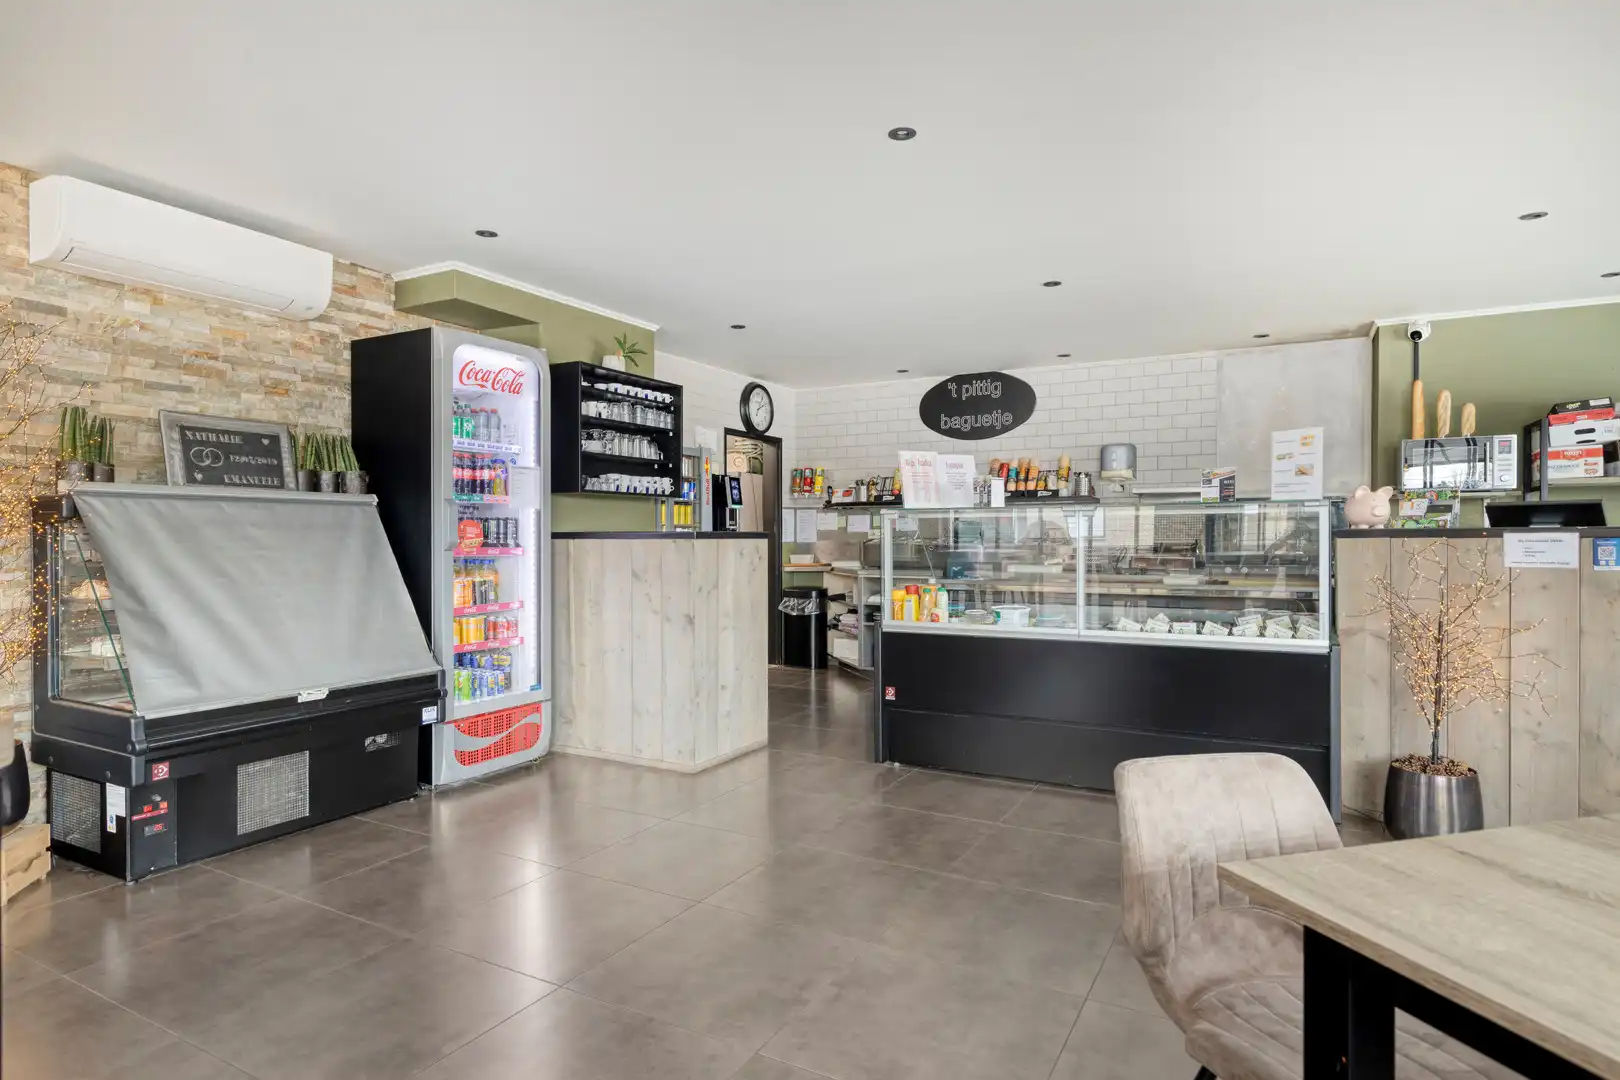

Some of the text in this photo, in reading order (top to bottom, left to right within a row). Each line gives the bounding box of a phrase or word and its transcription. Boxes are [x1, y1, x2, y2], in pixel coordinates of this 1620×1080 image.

[458, 360, 525, 395] Coca-Cola
[948, 379, 1001, 400] 't pittig
[940, 410, 1013, 431] baguetje
